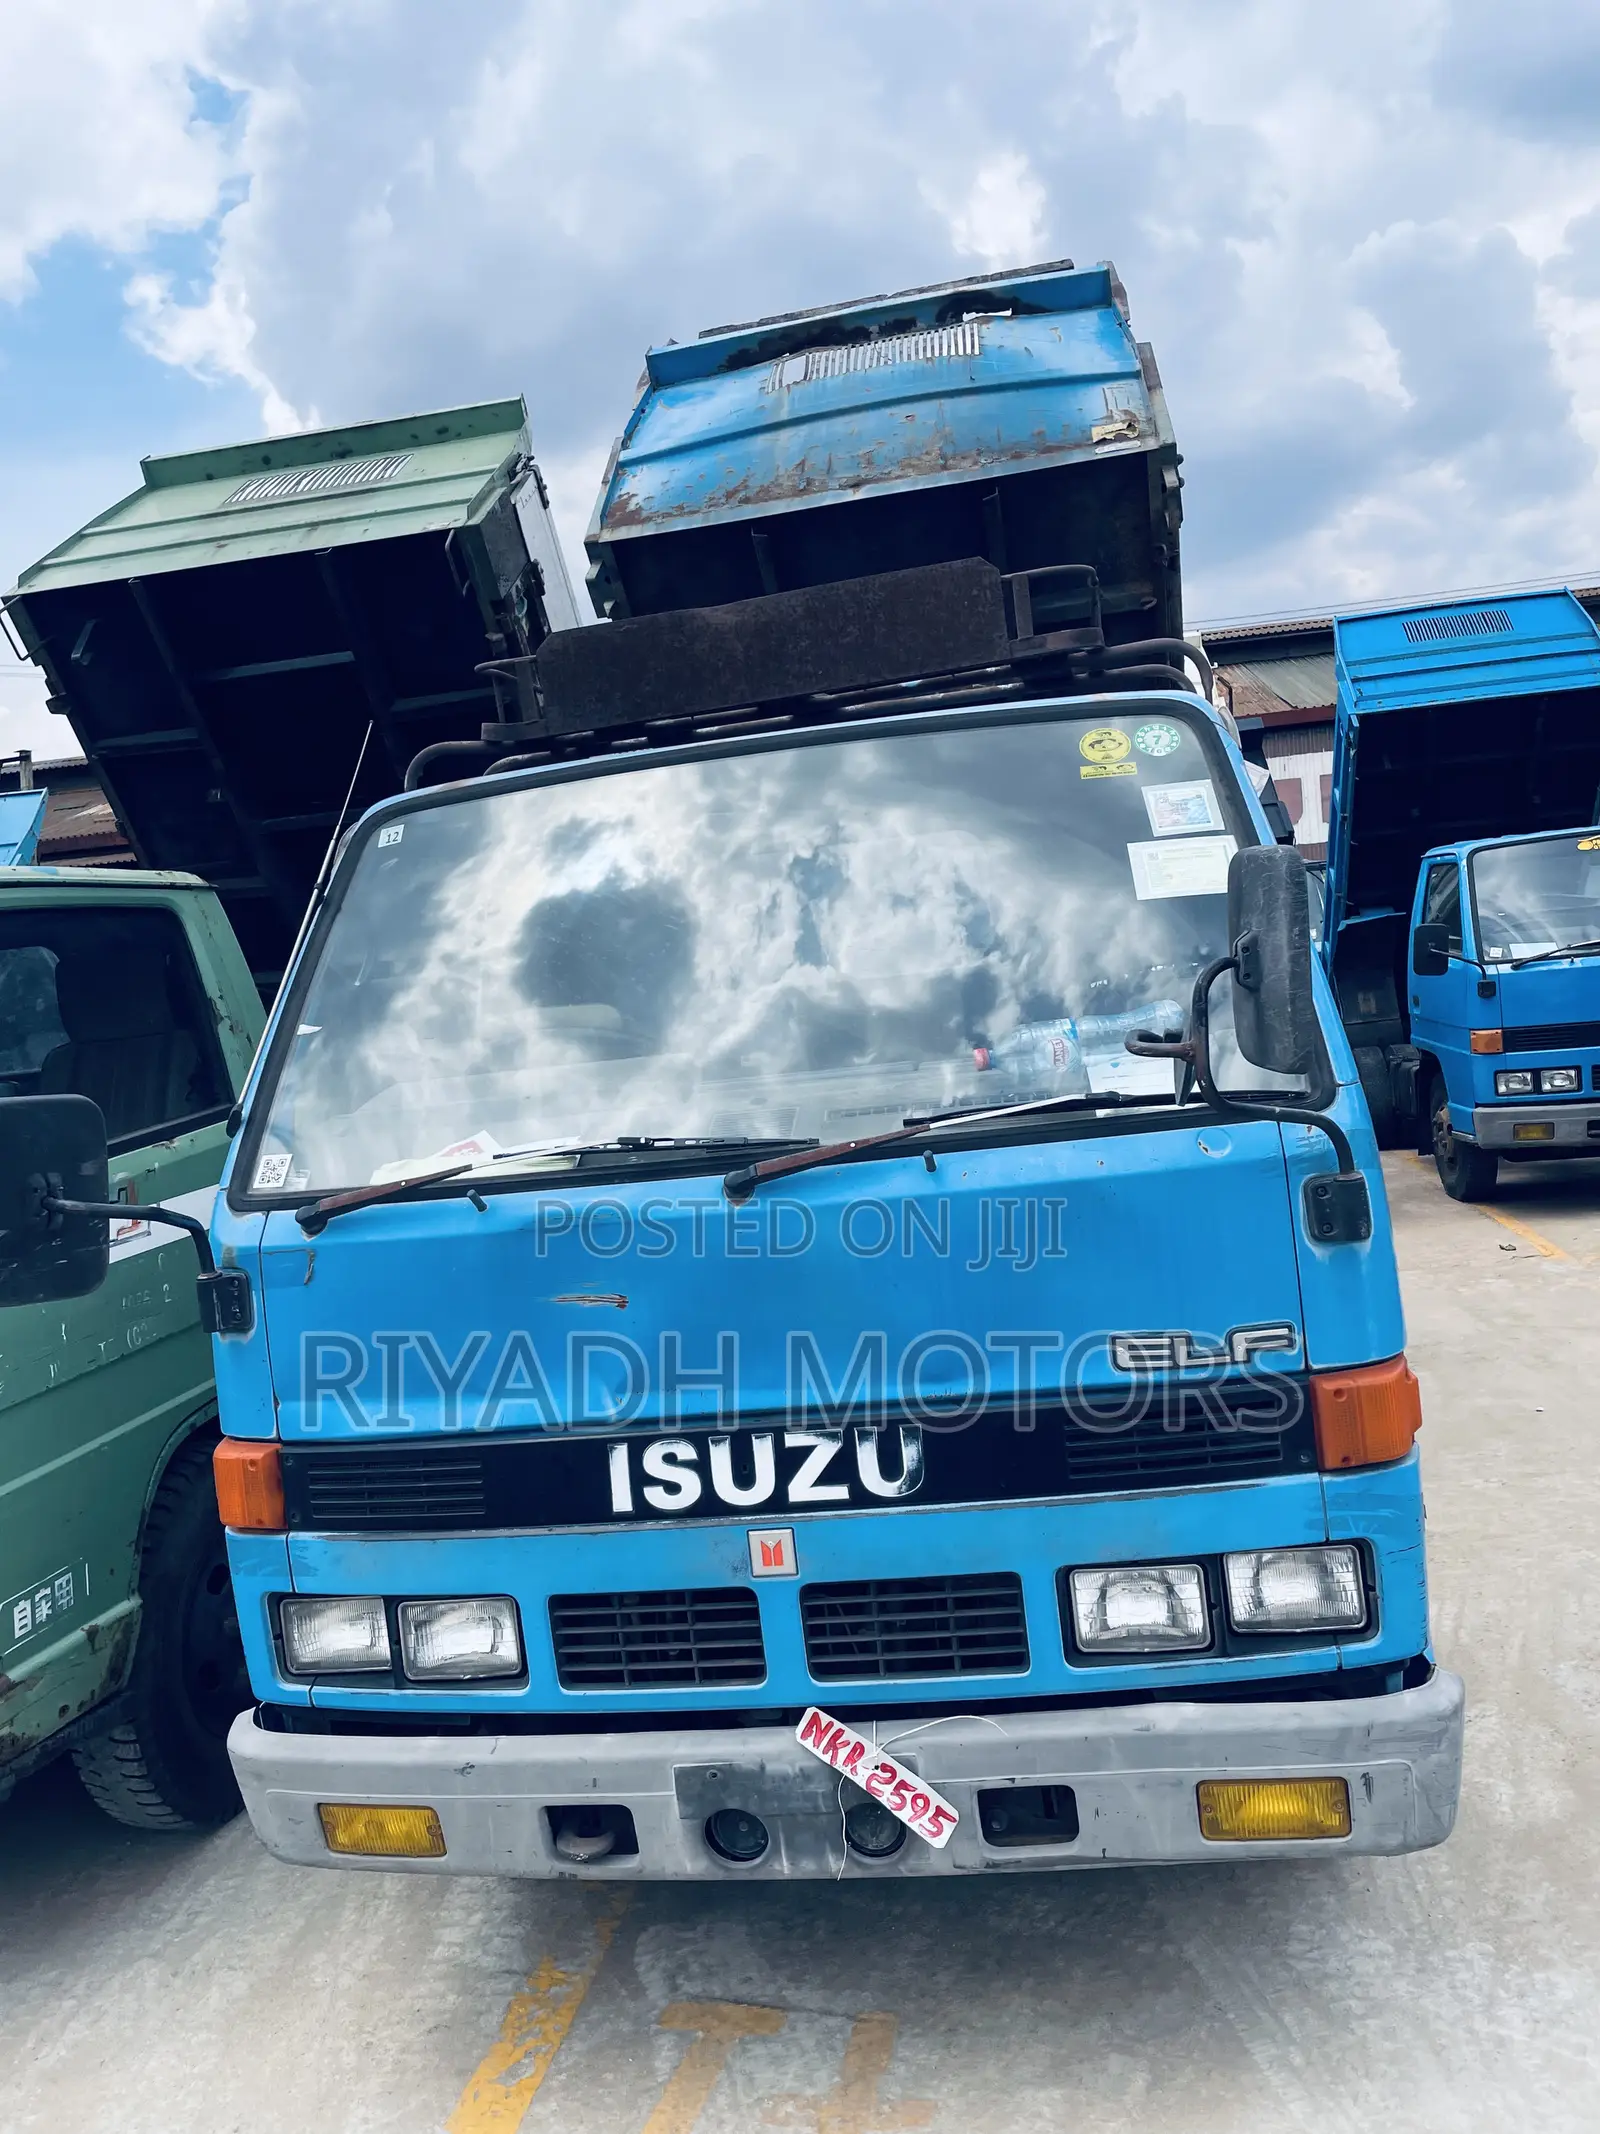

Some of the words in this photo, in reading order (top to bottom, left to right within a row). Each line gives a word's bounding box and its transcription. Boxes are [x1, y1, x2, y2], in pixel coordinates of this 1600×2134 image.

[1153, 734, 1162, 746] 7
[386, 831, 399, 844] 12
[1110, 1321, 1296, 1372] ELF
[608, 1423, 925, 1514] ISUZU
[13, 1572, 74, 1640] 自家用
